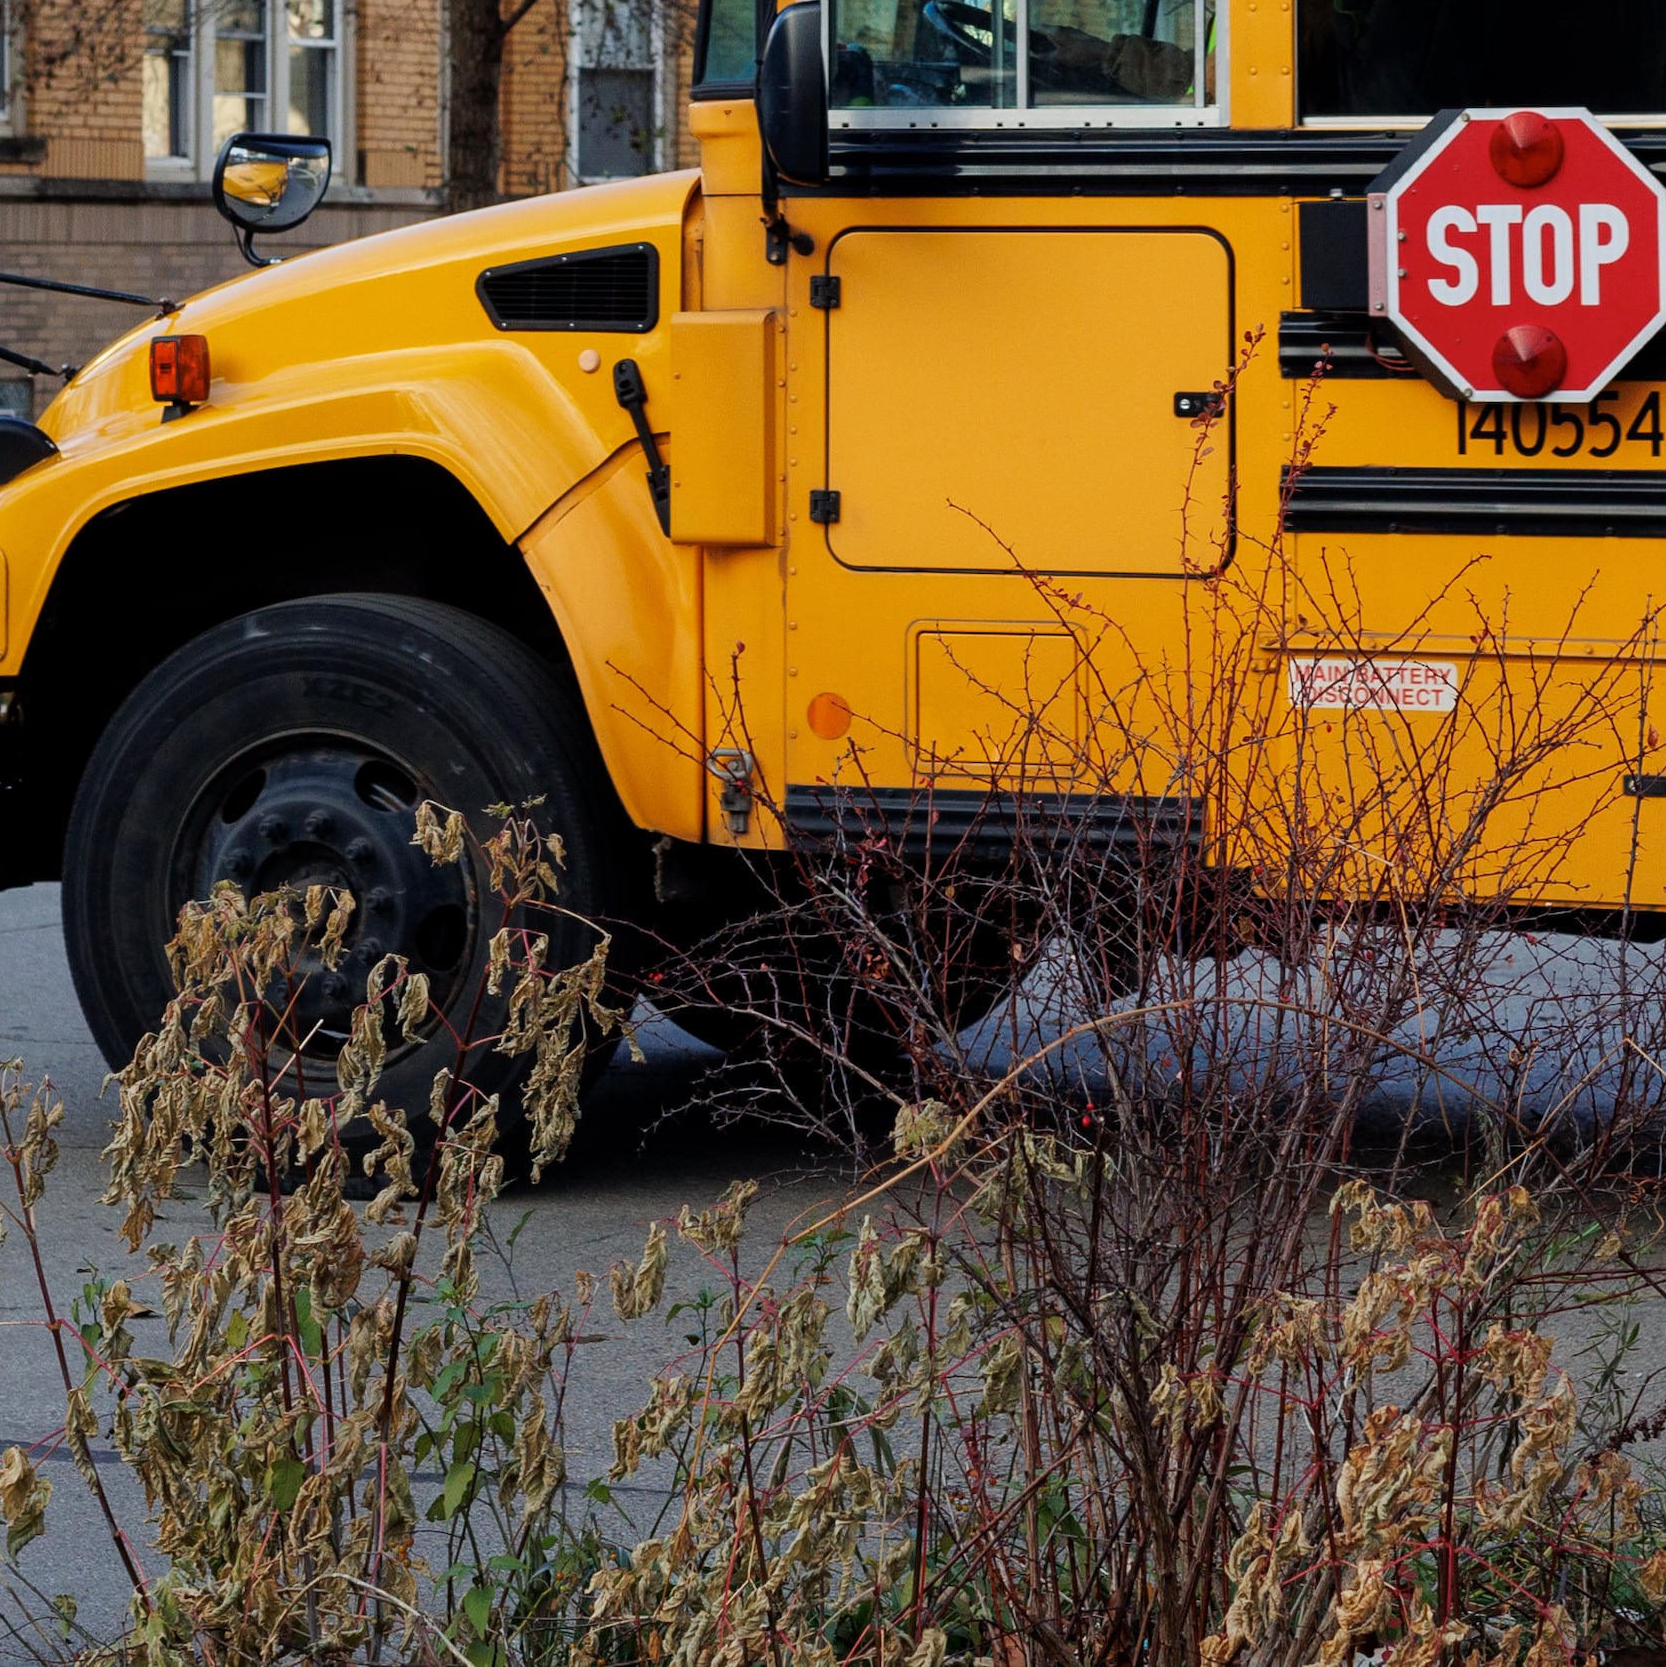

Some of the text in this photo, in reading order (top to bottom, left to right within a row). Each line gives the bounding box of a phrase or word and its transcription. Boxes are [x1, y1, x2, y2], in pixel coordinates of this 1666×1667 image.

[1426, 203, 1630, 307] STOP
[1457, 390, 1664, 458] 140554
[1294, 665, 1452, 686] MAIN BATTERY
[1303, 685, 1444, 706] DISCONNECT
